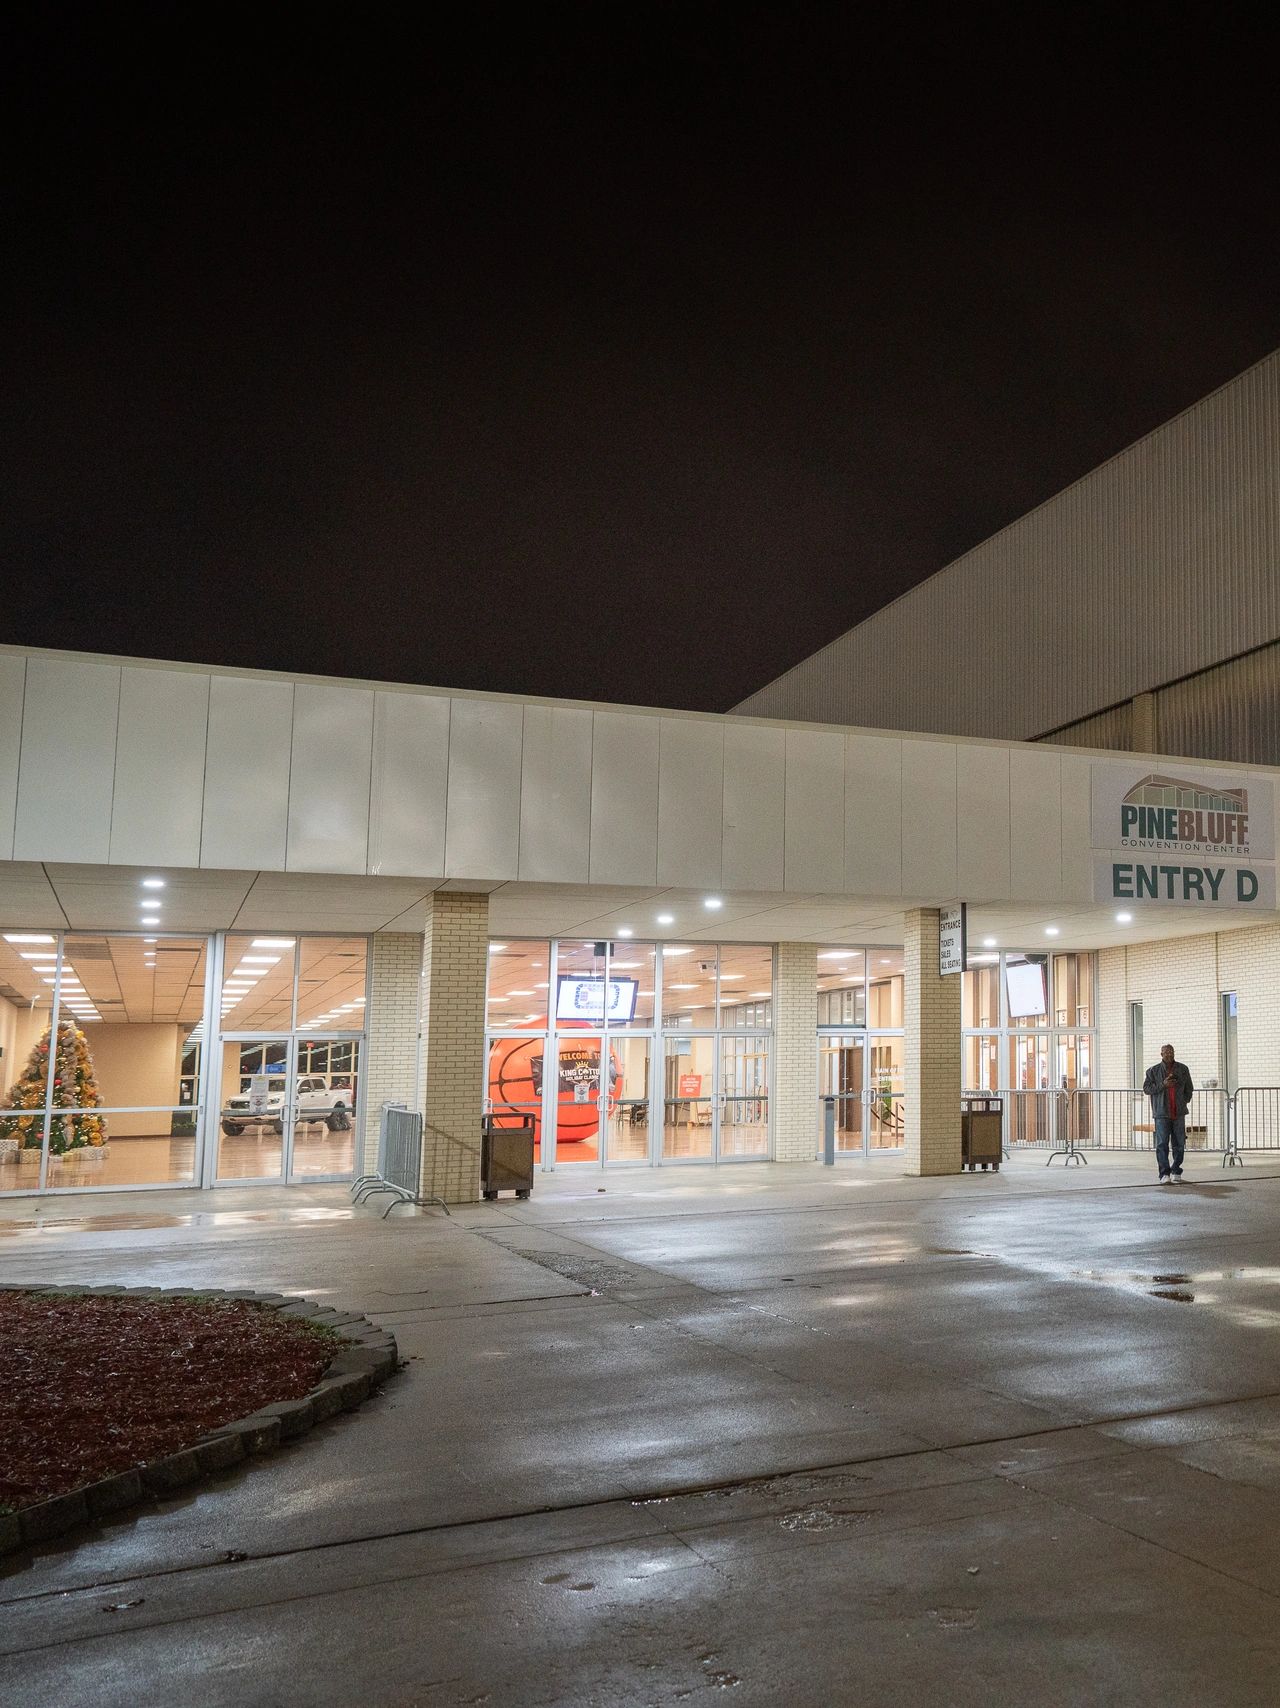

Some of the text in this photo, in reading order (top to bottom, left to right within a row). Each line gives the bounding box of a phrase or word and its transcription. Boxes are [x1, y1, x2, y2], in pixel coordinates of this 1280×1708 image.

[1121, 838, 1250, 855] CONVENTION CENTER
[1112, 863, 1259, 902] ENTRY D
[941, 919, 961, 932] ENTRANCE
[560, 1068, 600, 1077] KING COTTO
